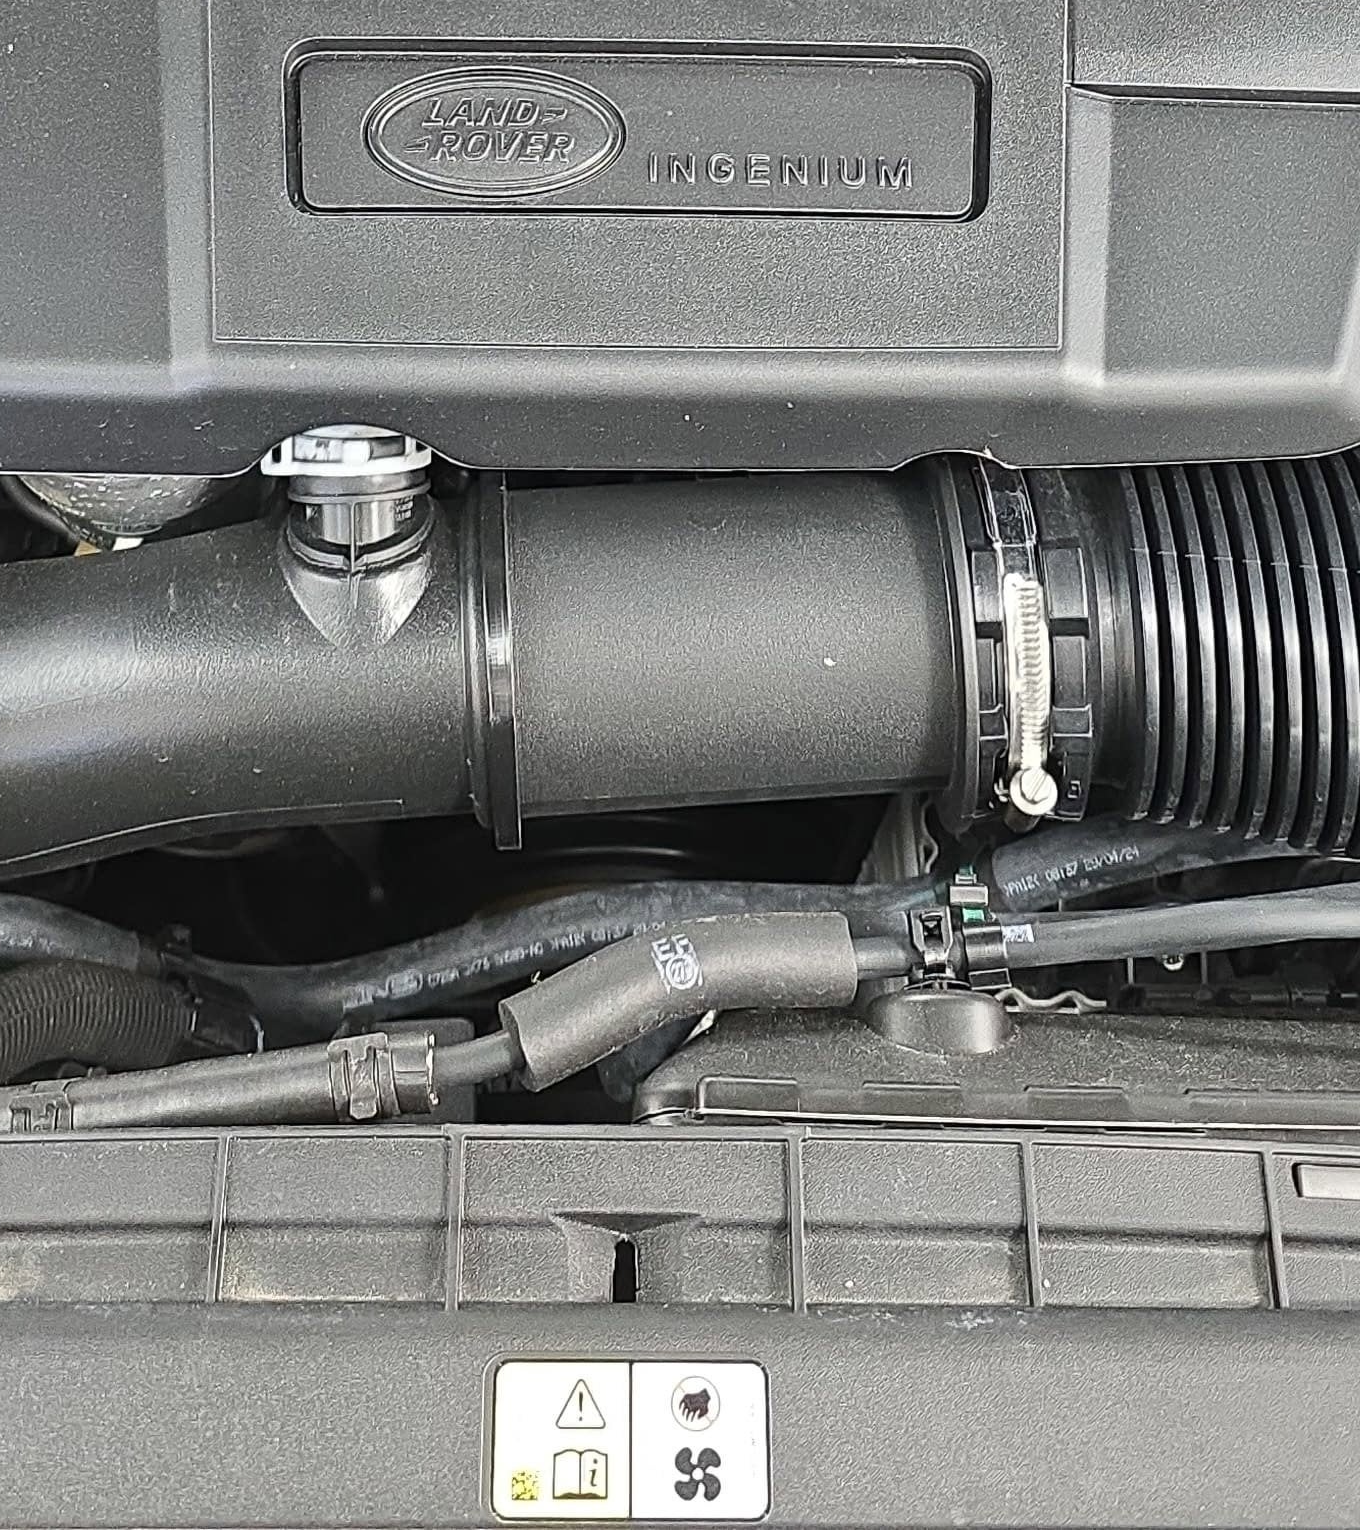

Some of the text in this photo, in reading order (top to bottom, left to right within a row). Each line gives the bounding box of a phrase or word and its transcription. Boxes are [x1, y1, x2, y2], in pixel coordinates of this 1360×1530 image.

[421, 97, 539, 128] LAND
[429, 130, 576, 164] ROVER
[647, 150, 915, 190] INGENIUM
